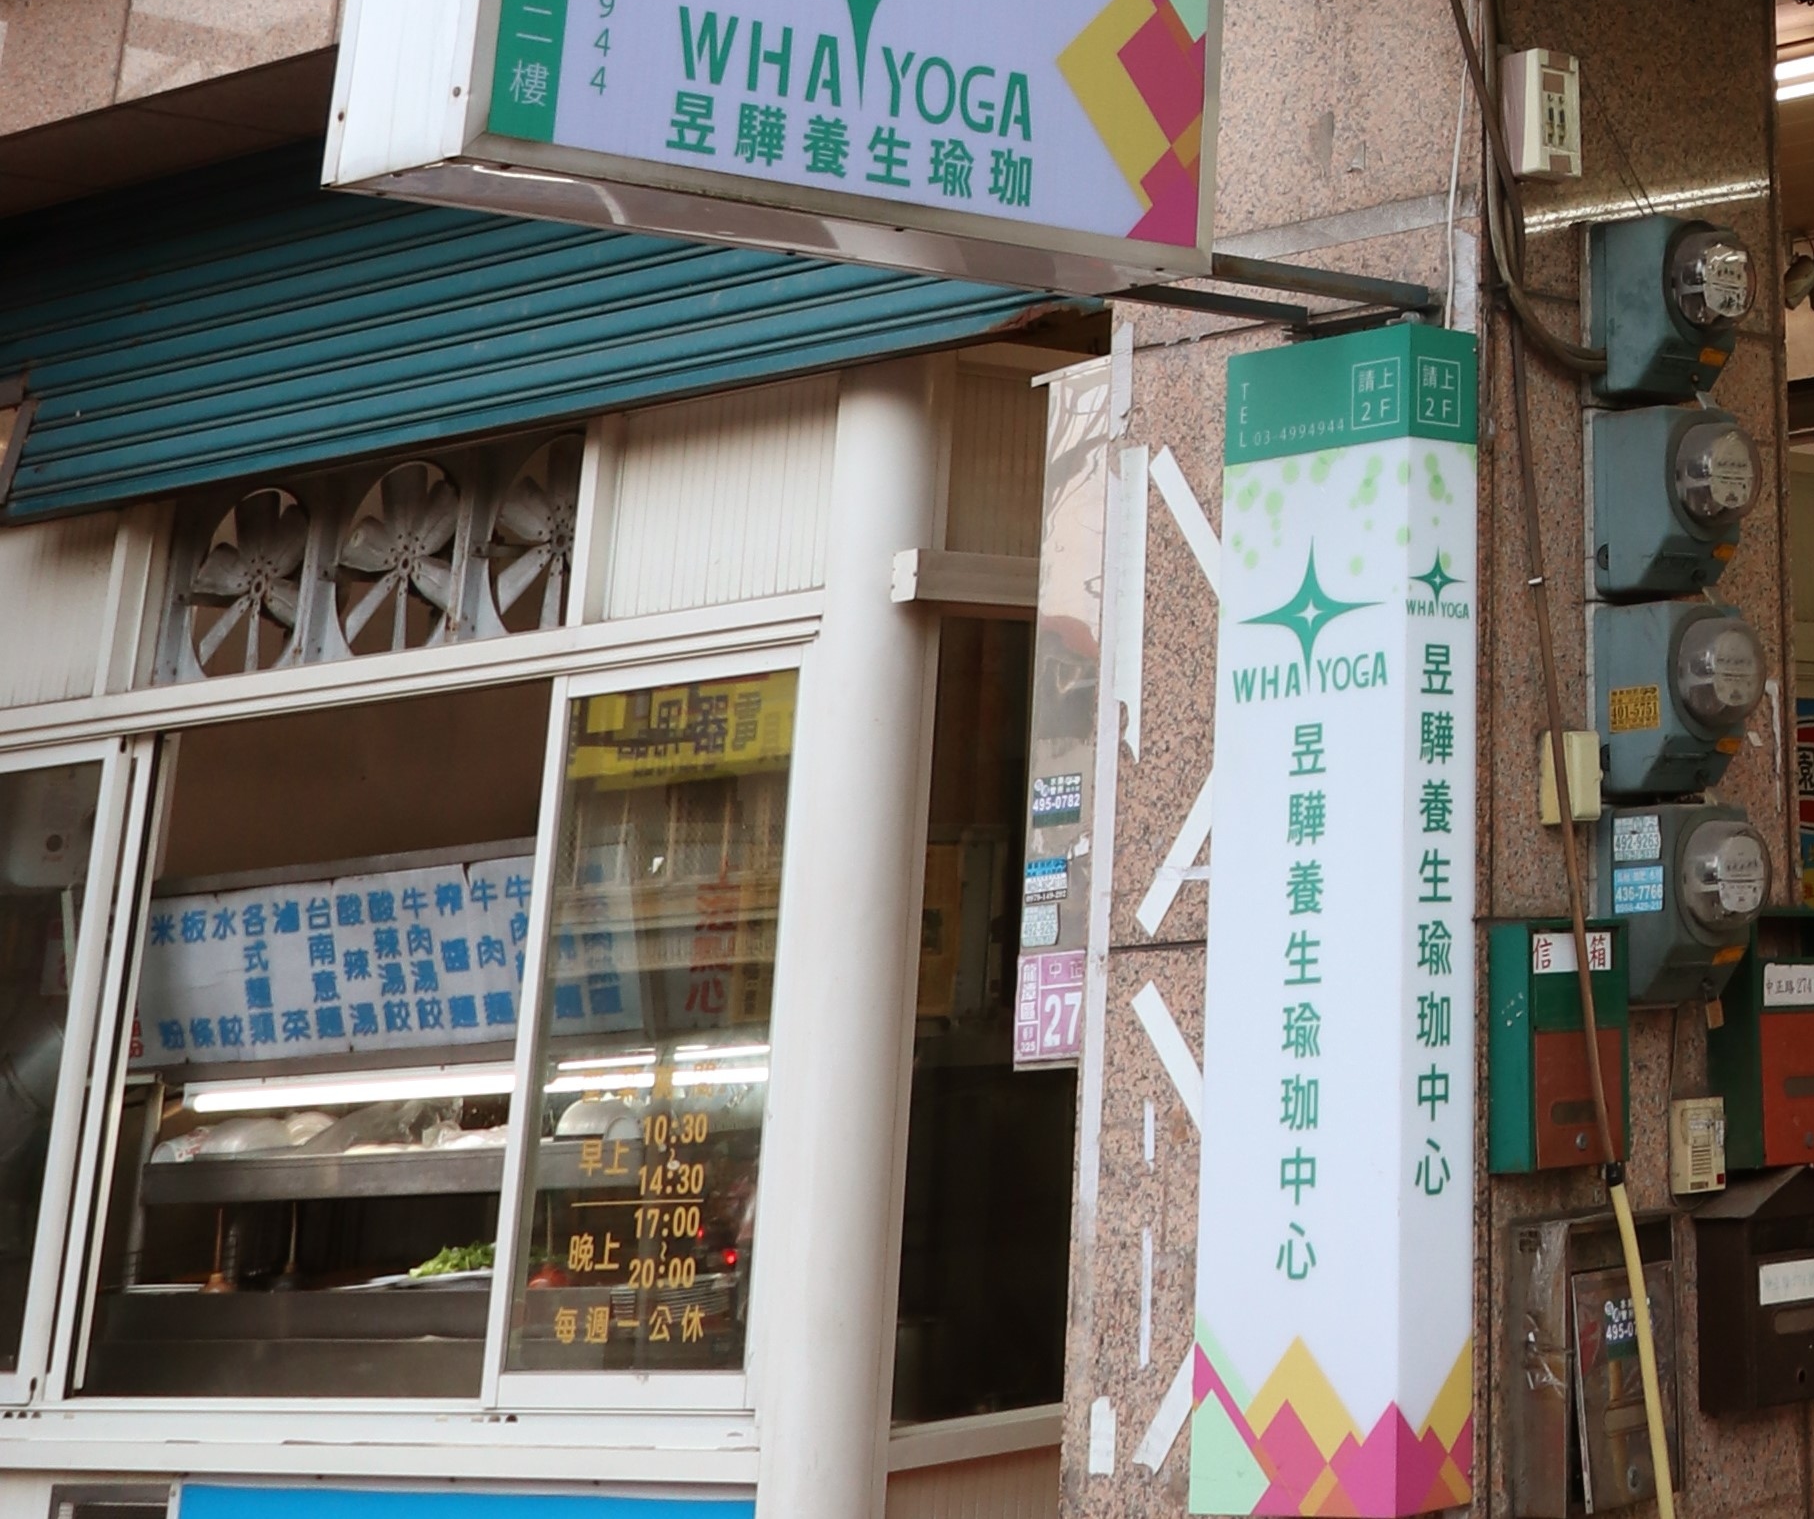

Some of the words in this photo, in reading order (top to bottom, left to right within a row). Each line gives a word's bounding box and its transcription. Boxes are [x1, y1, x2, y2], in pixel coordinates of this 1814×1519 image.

[679, 6, 841, 108] WHA
[881, 46, 1033, 142] YOGA
[666, 91, 1032, 208] 昱驊養生瑜珈
[1358, 367, 1394, 393] 請上
[1422, 364, 1455, 390] 請上
[1405, 599, 1437, 618] WHA
[1439, 601, 1470, 619] YOGA
[1233, 660, 1302, 705] WHA
[1317, 649, 1388, 695] YOGA
[1032, 793, 1081, 812] 495-0782
[1413, 641, 1456, 1198] 昱驊養生瑜珈中心
[1275, 721, 1329, 1283] 昱驊養生瑜珈中心
[643, 1113, 709, 1146] 10:30
[579, 1138, 630, 1177] 早上
[638, 1163, 704, 1196] 14:30
[633, 1206, 701, 1239] 17:00
[568, 1232, 621, 1273] 晚上
[628, 1257, 697, 1289] 20:00
[554, 1304, 706, 1344] 每週一公休
